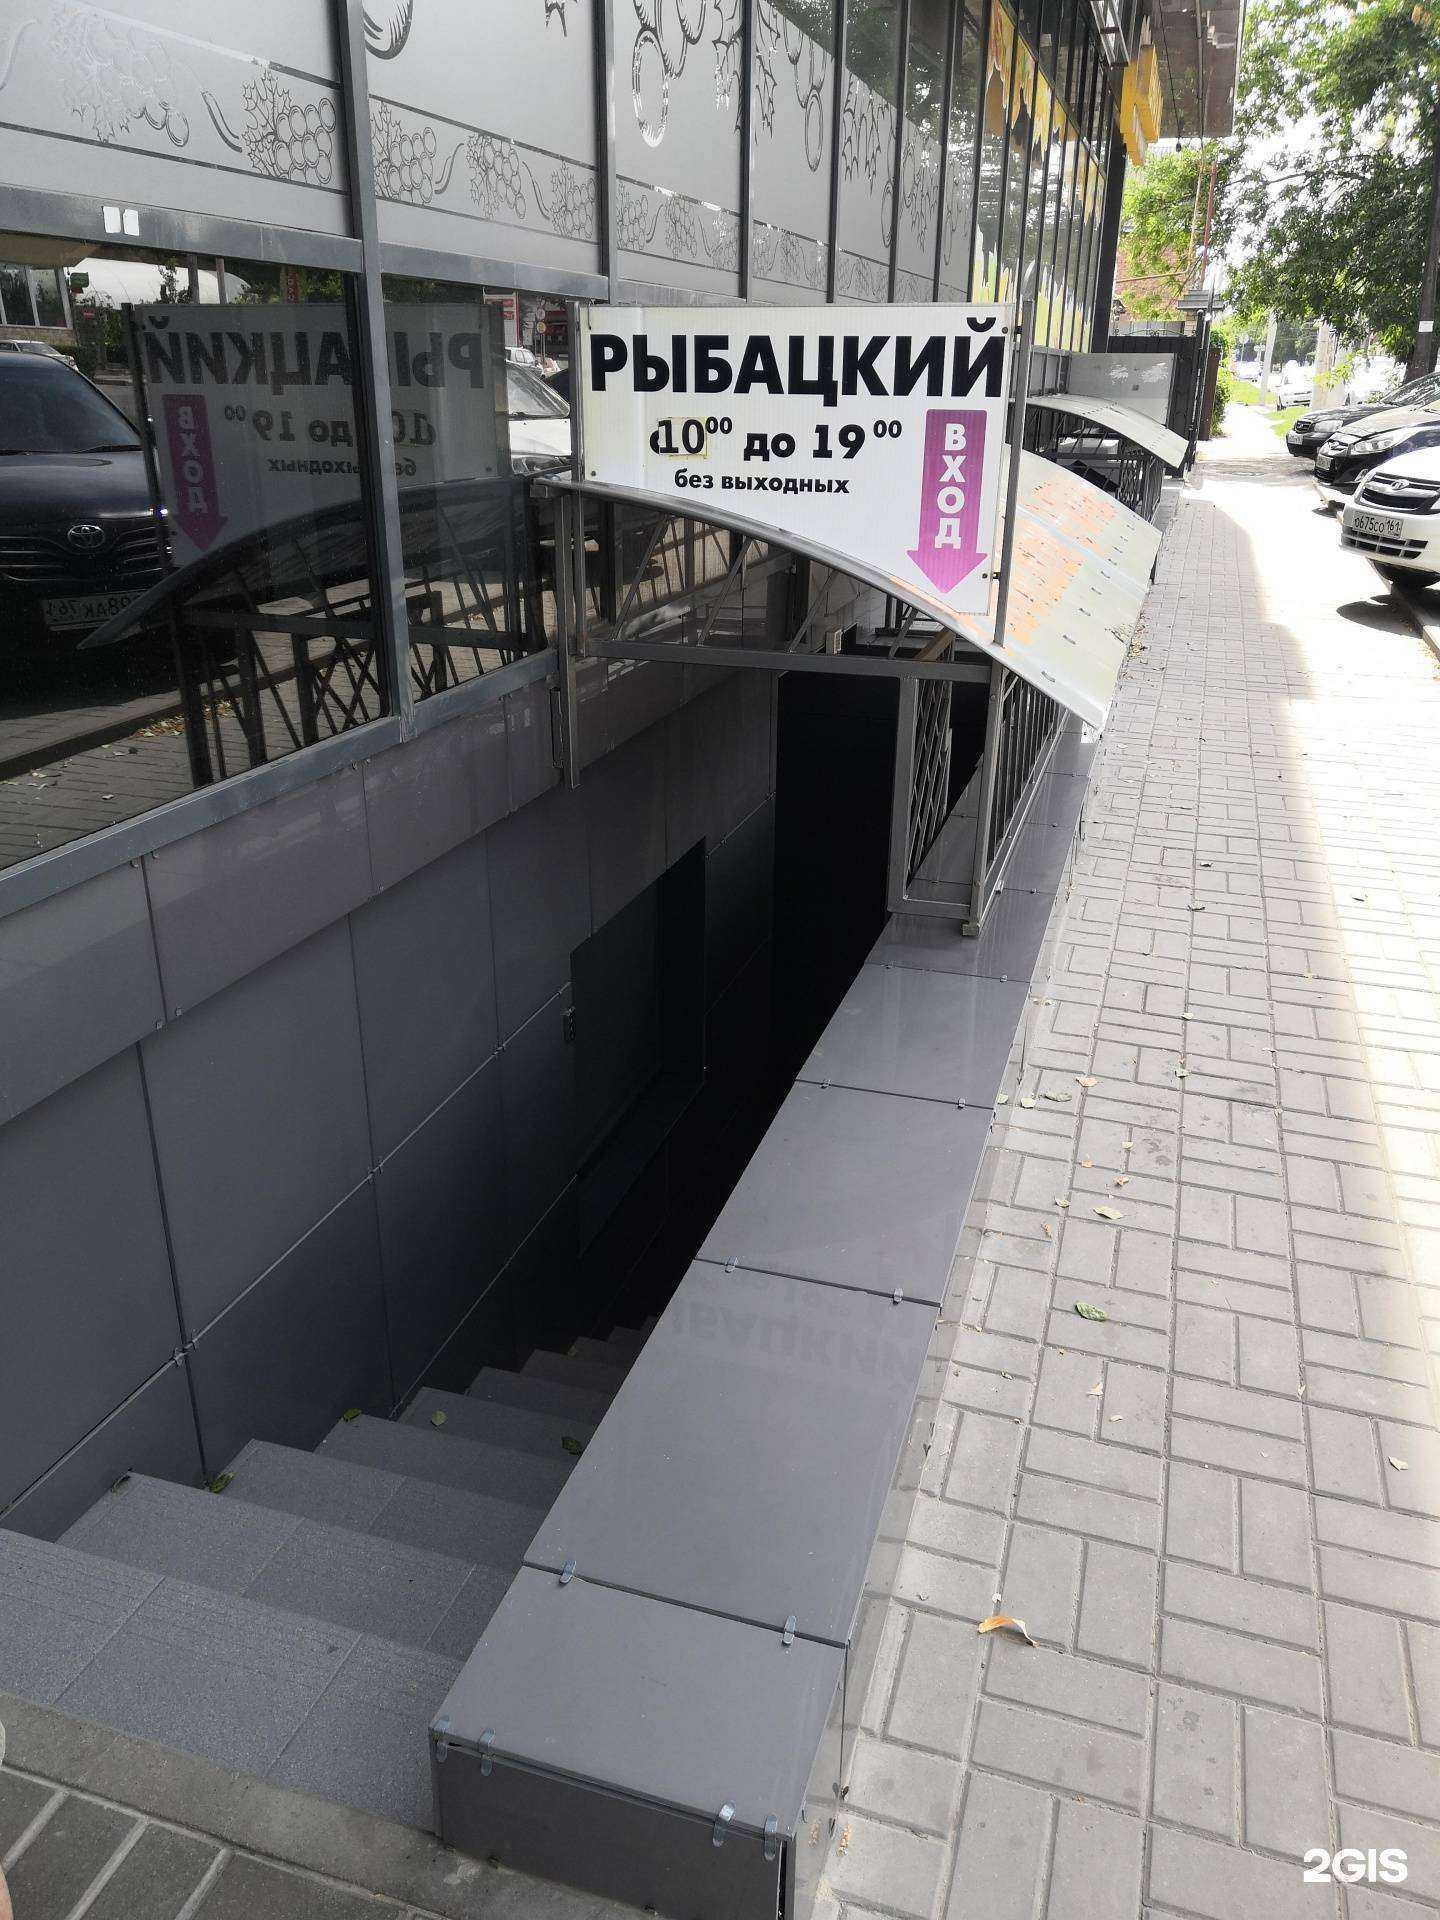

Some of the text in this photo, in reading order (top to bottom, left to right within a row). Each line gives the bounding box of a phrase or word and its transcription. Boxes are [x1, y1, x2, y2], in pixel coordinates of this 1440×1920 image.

[590, 317, 1006, 407] РЫБАЦКИЙ
[743, 432, 796, 461] до
[674, 467, 850, 495] без выходных
[934, 423, 967, 549] ВХОД
